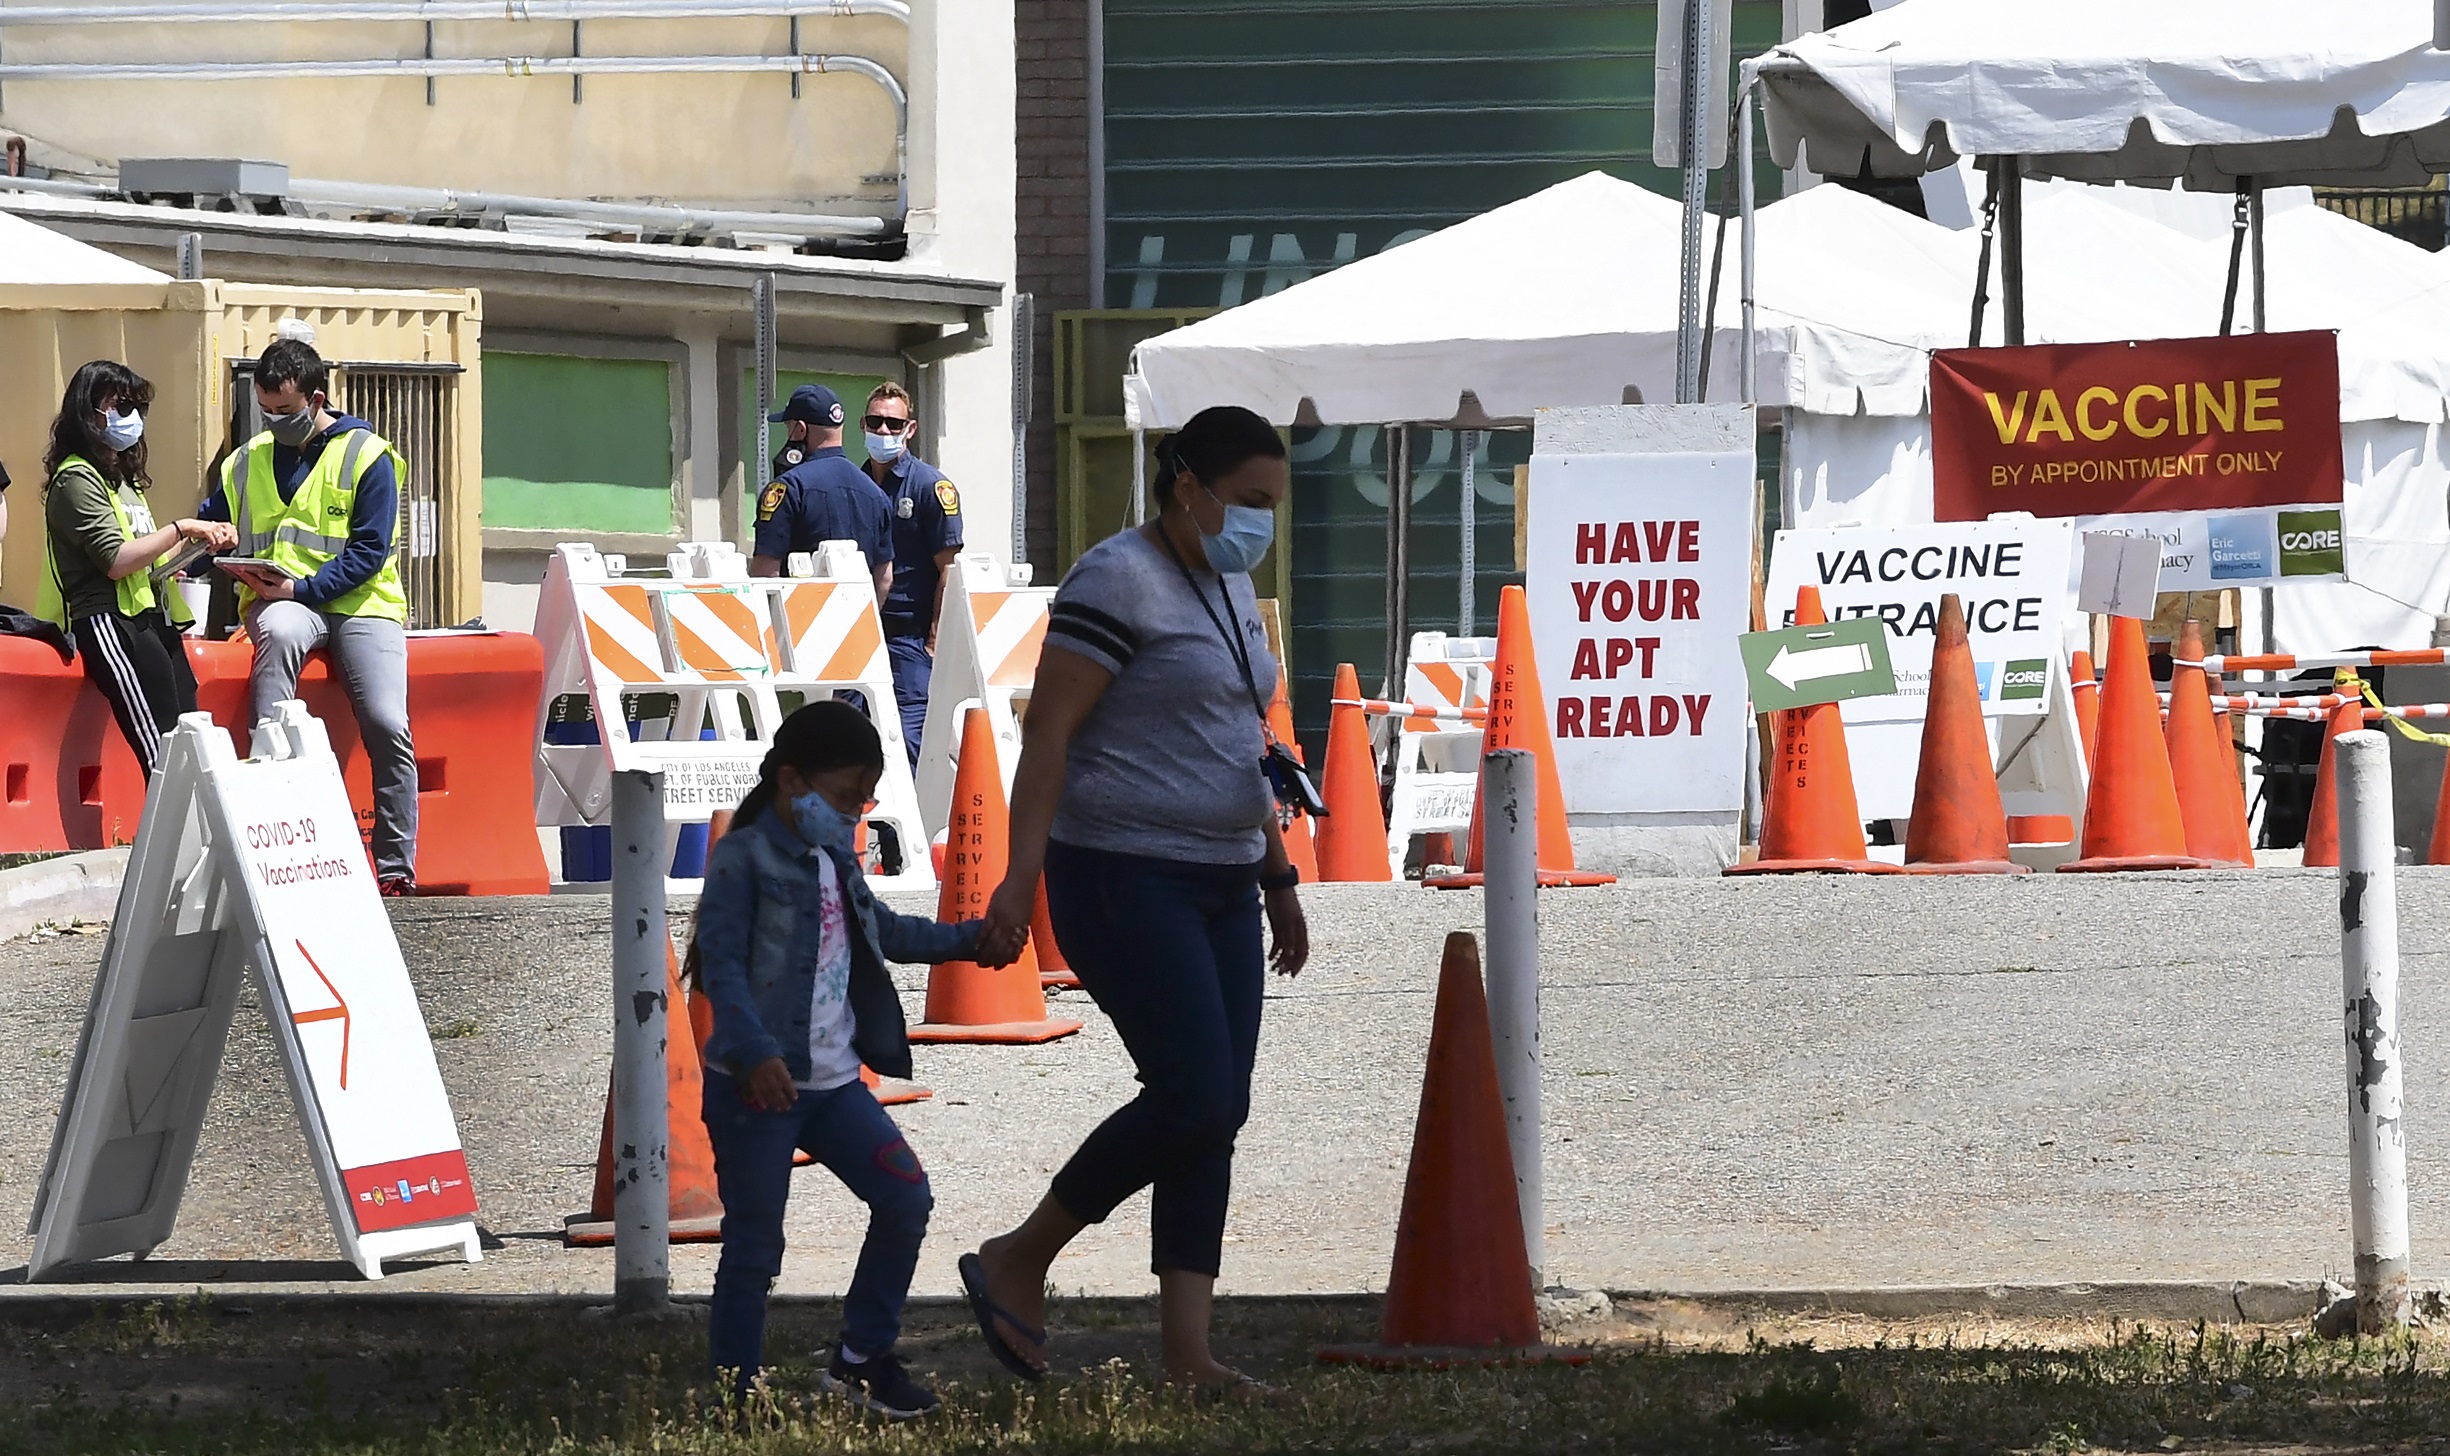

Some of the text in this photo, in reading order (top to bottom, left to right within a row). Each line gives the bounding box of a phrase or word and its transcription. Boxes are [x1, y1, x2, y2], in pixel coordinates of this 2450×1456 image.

[1983, 377, 2284, 444] VACCINE
[1991, 451, 2283, 487] BY APPOINTMENT ONLY
[1576, 521, 1700, 564] HAVE
[2211, 537, 2234, 549] Eric
[2281, 530, 2341, 550] CORE
[1816, 542, 2024, 585] VACCINE
[1570, 578, 1700, 622] YOUR
[1570, 637, 1661, 680] APT
[2004, 671, 2045, 684] CORE
[1557, 694, 1712, 738] READY
[680, 774, 692, 786] OF
[696, 774, 731, 786] PUBLIC
[682, 762, 692, 773] OF
[695, 762, 710, 773] LOS
[714, 761, 751, 773] ANGELES
[663, 787, 703, 804] TREET
[246, 817, 316, 849] COVID-19
[256, 854, 353, 886] Vaccinations.
[970, 793, 983, 920] SERVICE
